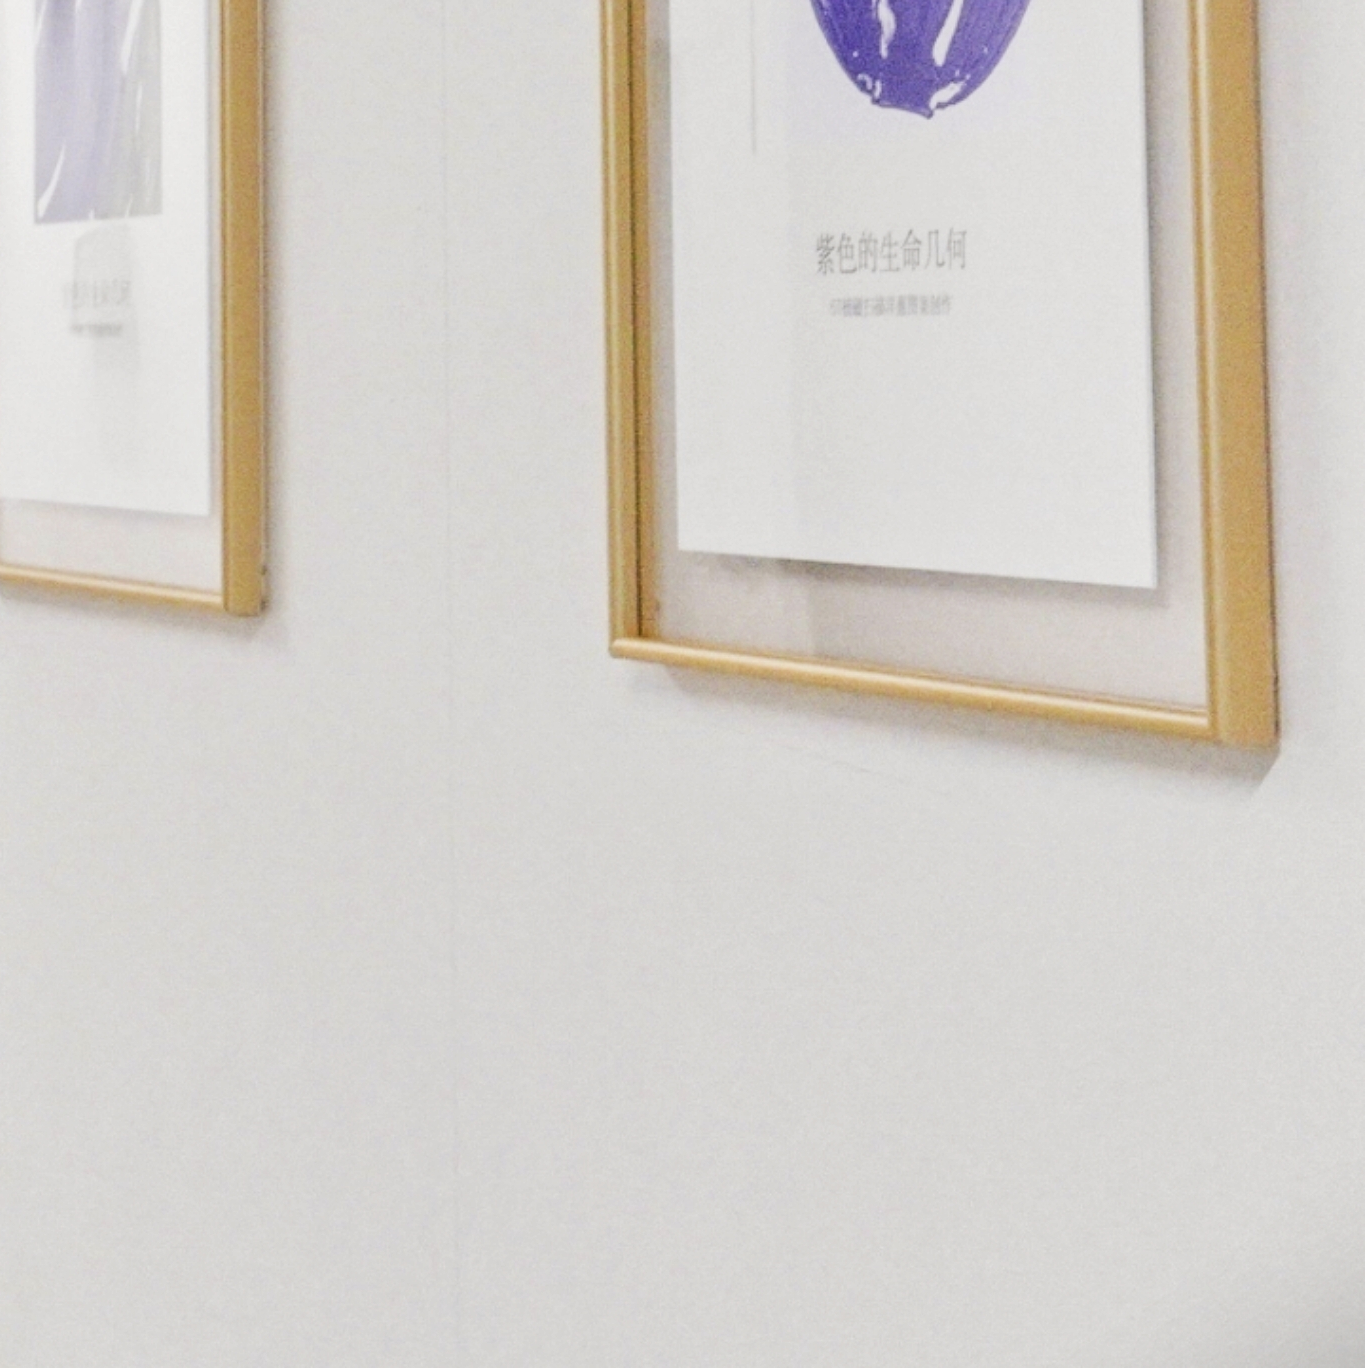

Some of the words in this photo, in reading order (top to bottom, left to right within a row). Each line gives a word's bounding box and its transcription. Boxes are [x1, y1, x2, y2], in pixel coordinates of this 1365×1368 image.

[816, 227, 968, 276] 紫色的生命几何
